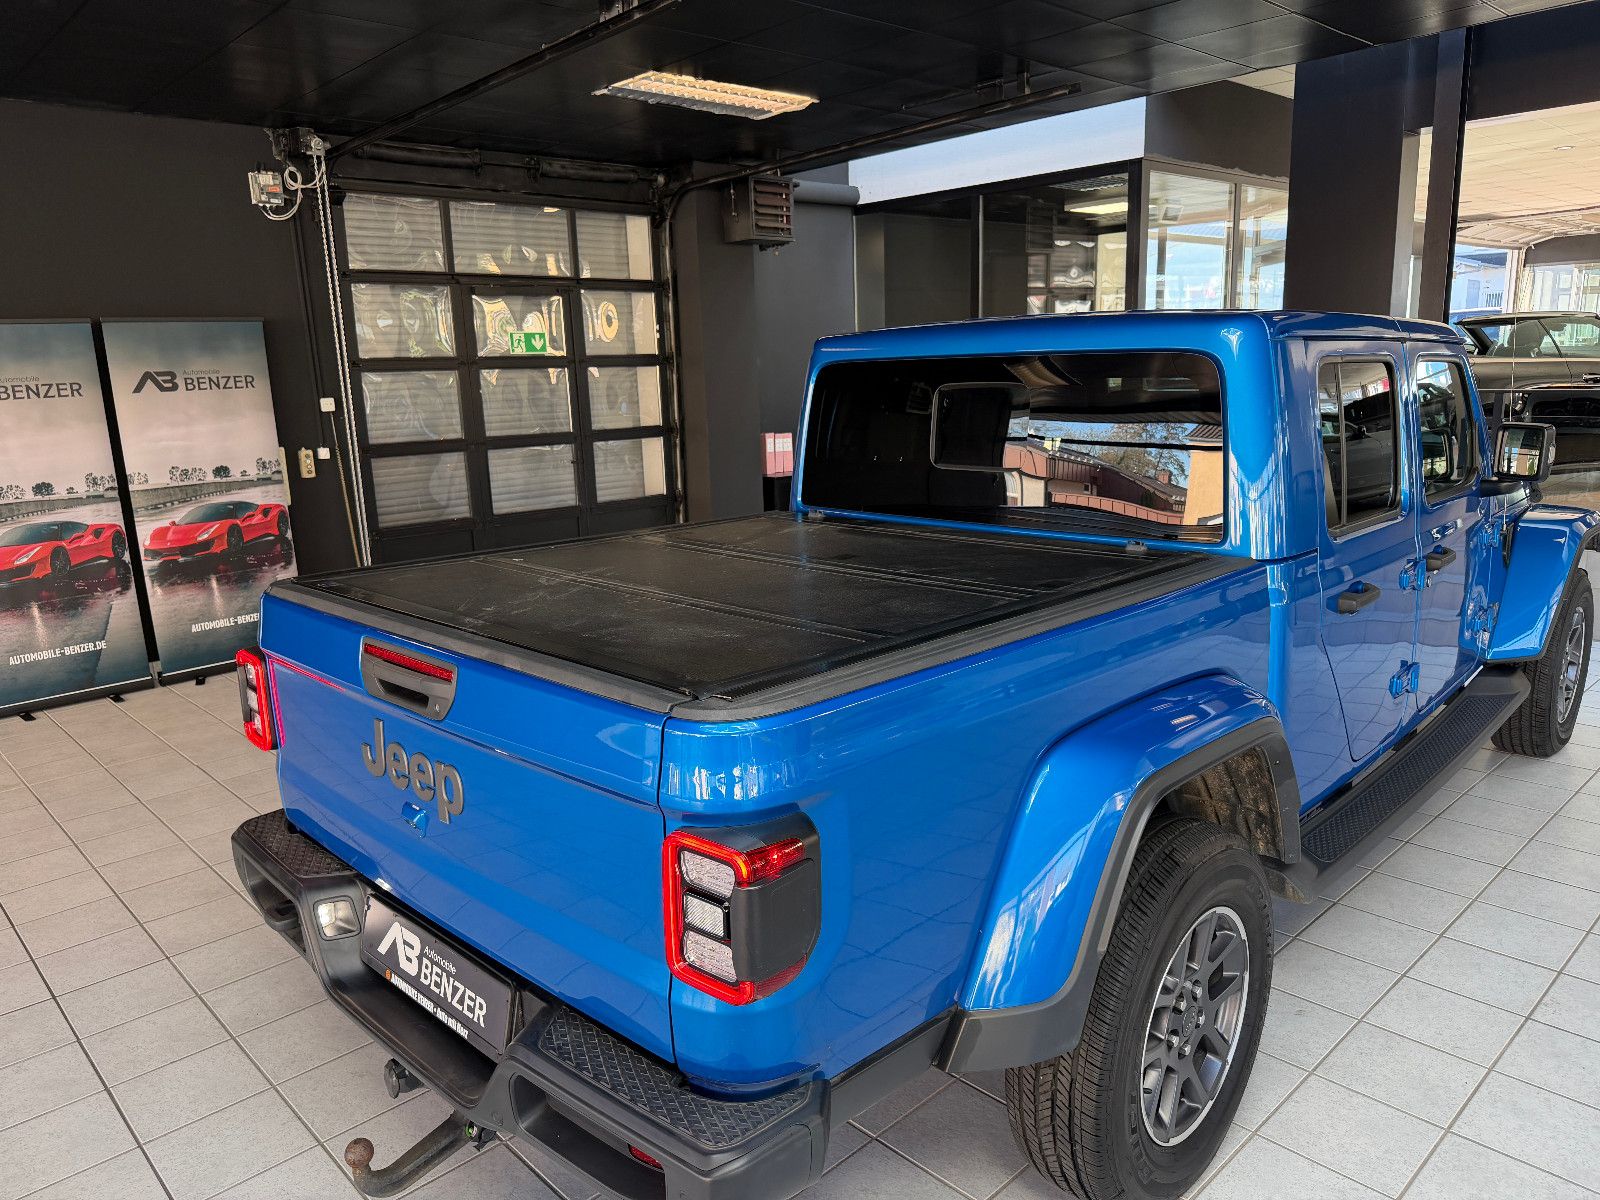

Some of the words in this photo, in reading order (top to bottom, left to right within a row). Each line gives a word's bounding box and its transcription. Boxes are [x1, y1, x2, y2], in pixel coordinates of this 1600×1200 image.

[0, 375, 40, 384] utomobile
[182, 368, 220, 376] Automobile
[184, 374, 256, 392] BENZER
[0, 382, 84, 401] BENZER
[9, 640, 107, 666] AUTOMOBILE-BENZER.DE
[361, 718, 464, 825] Jeep
[423, 945, 457, 975] Automobile
[419, 957, 488, 1028] BENZER
